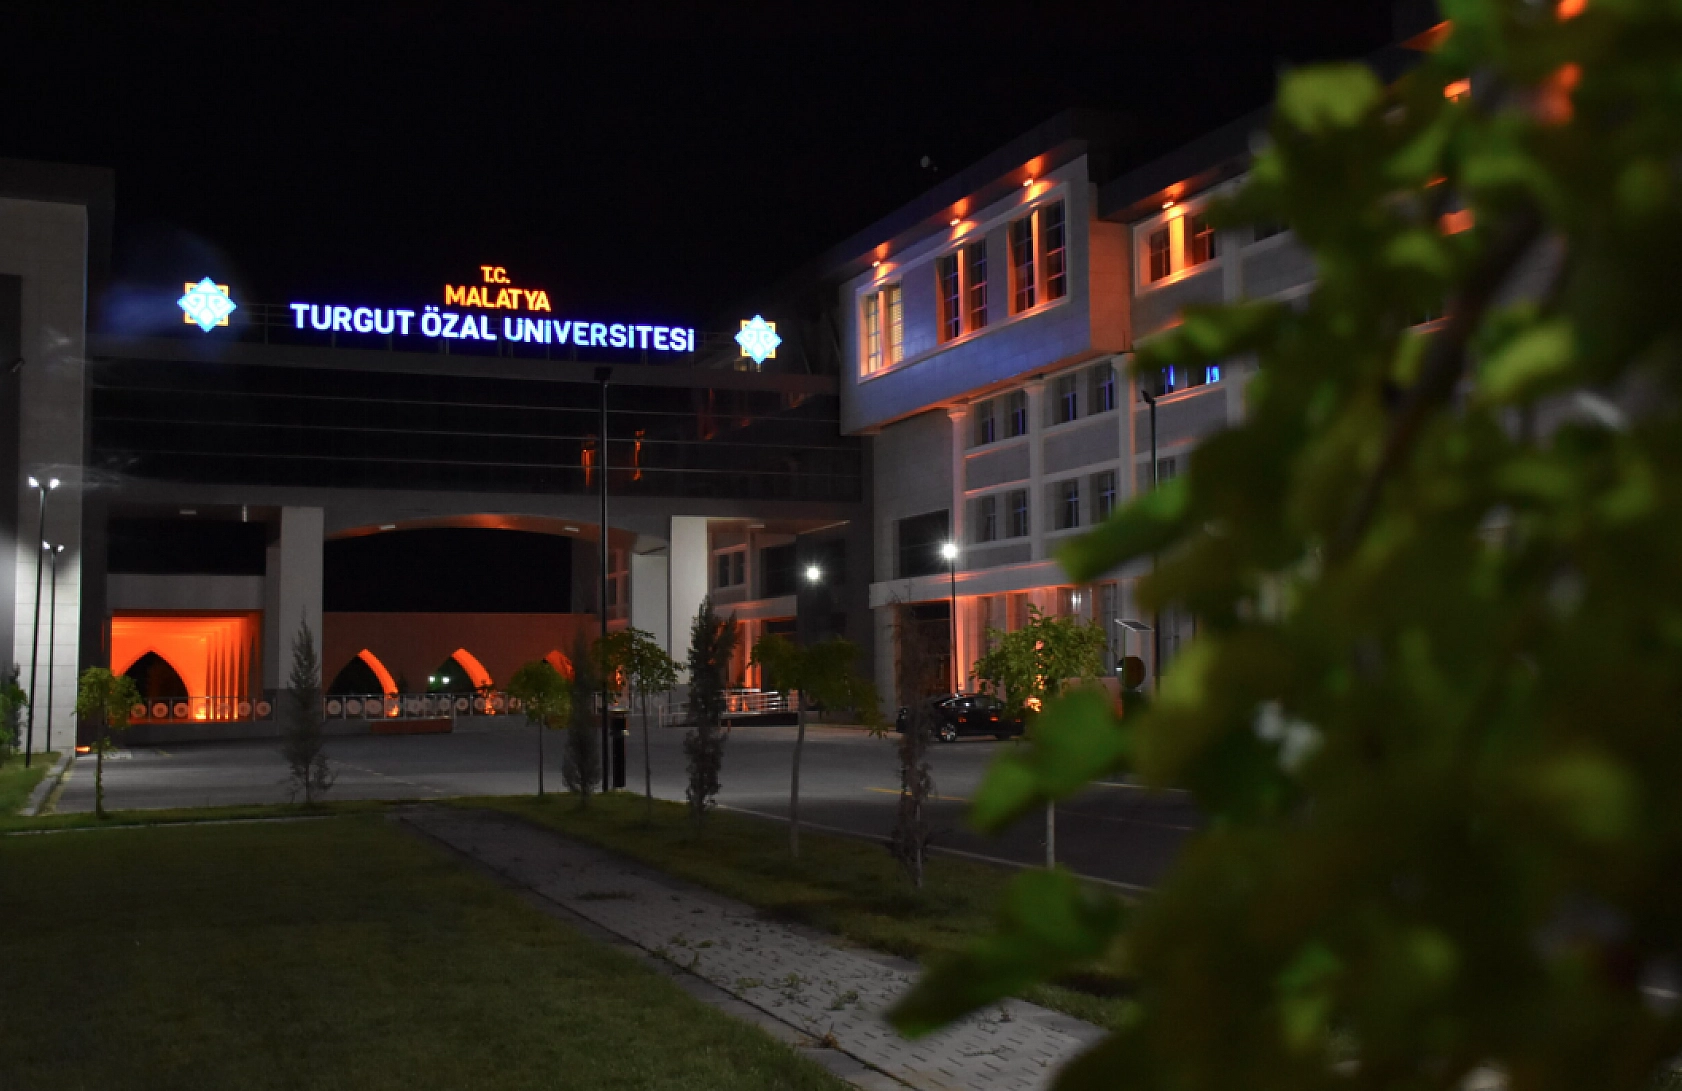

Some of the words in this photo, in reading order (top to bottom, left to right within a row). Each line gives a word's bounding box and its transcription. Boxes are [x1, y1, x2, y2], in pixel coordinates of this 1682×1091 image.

[481, 266, 511, 284] T.C.
[445, 284, 551, 312] MALATYA
[290, 303, 415, 335] TURGUT
[421, 305, 498, 341] ÖZAL
